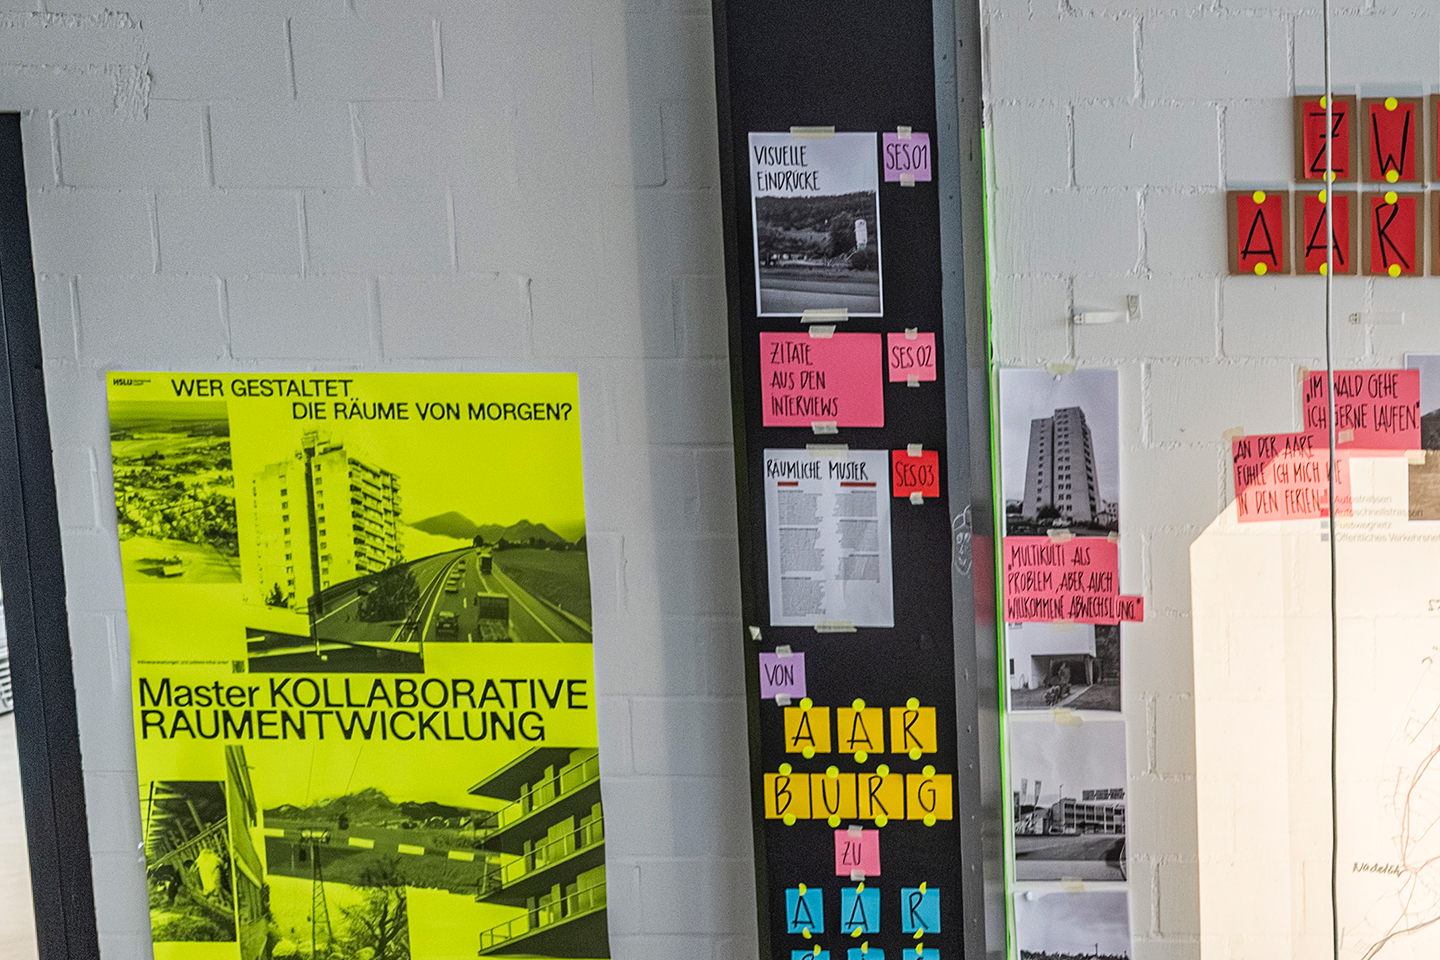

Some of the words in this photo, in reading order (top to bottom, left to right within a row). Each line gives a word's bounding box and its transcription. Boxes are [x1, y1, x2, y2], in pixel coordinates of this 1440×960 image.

[754, 145, 808, 168] VISUELLE
[171, 378, 225, 397] WER
[231, 378, 352, 398] GESTALTET
[771, 371, 796, 390] AUS
[800, 370, 826, 390] DEN
[1368, 373, 1399, 398] GEHE
[292, 402, 329, 420] DIE
[334, 397, 409, 421] RÄUME
[415, 402, 461, 421] VON
[468, 402, 573, 422] MORGEN?
[829, 460, 869, 481] MUSTER
[1071, 546, 1091, 567] ALS
[1087, 571, 1113, 593] AUCH
[764, 663, 794, 687] VON
[138, 677, 260, 708] Master
[269, 677, 589, 710] KOLLABORATIVE
[140, 709, 545, 741] RAUMENTWICKLUNG
[842, 840, 862, 867] ZU
